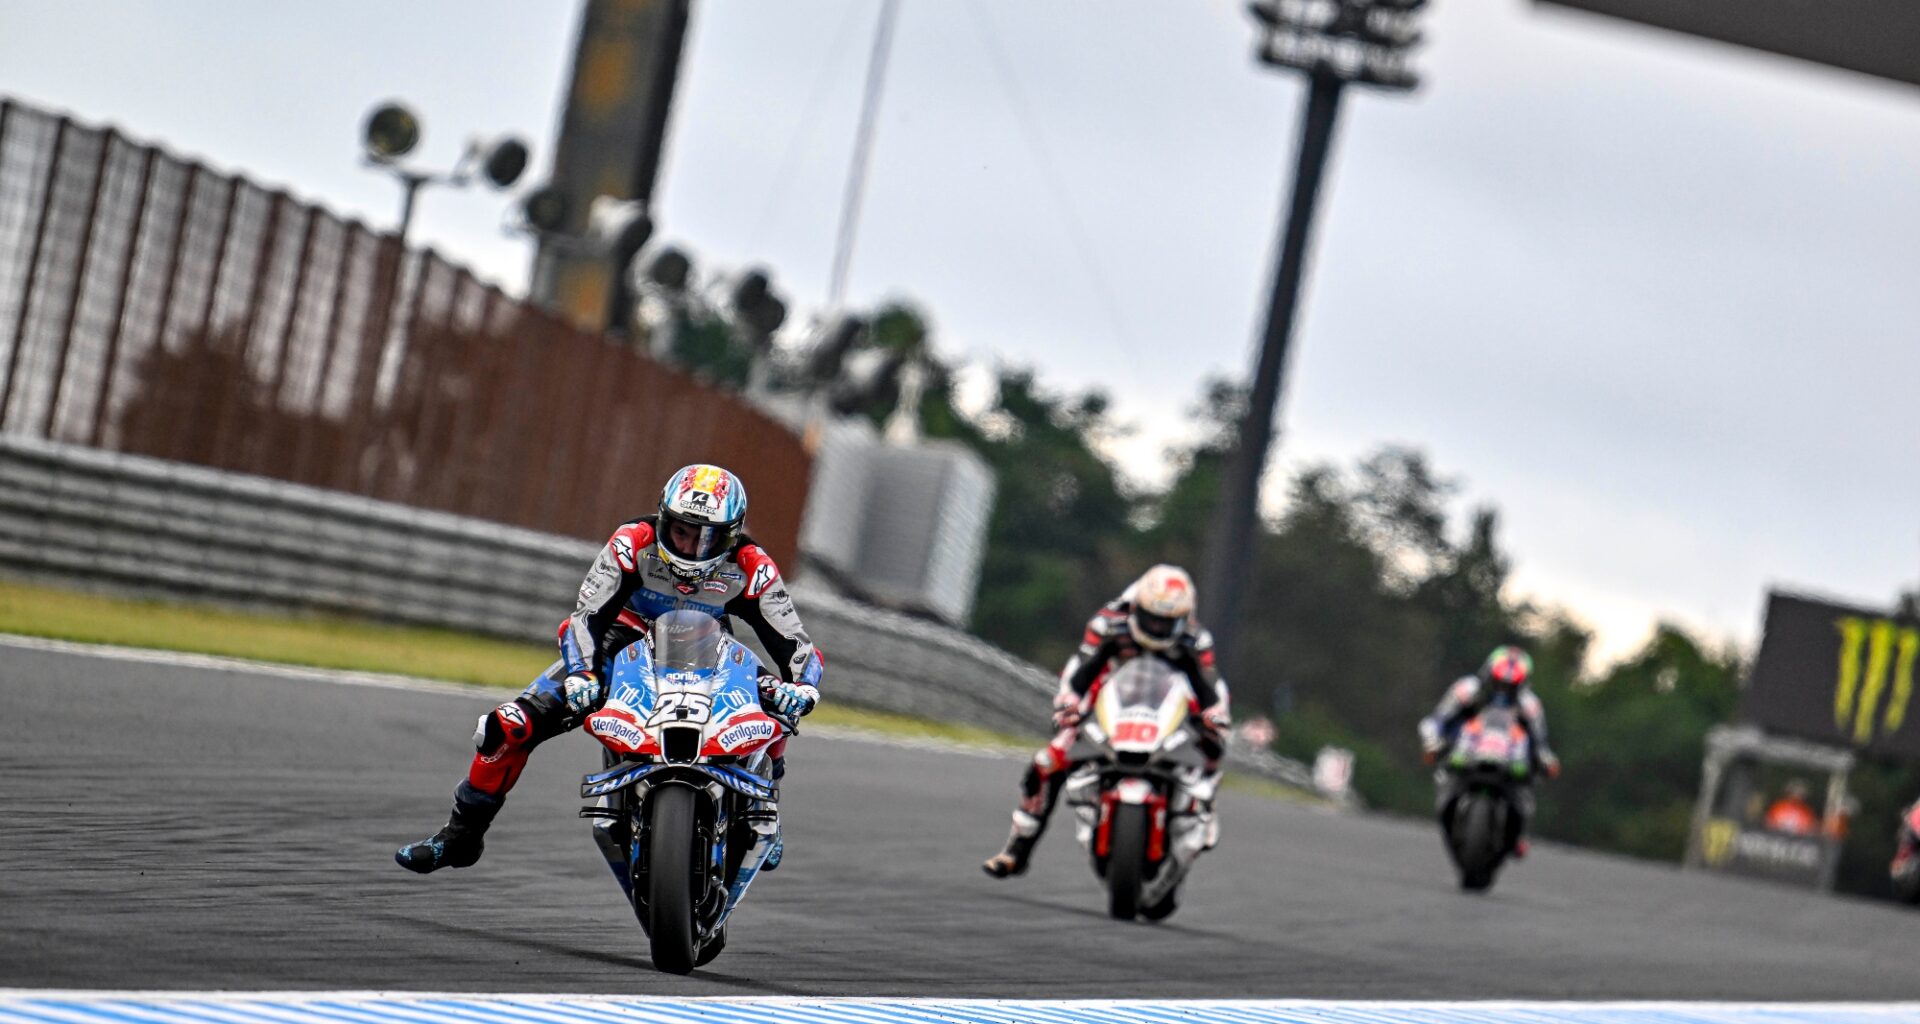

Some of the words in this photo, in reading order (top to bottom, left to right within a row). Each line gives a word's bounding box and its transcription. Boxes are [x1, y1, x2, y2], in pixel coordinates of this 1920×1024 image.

[680, 500, 716, 515] SHARK
[671, 565, 700, 578] aprilia
[665, 671, 702, 681] aprilia
[645, 692, 712, 728] 25
[592, 719, 642, 746] sterilgarda
[720, 722, 773, 748] sterilgarda
